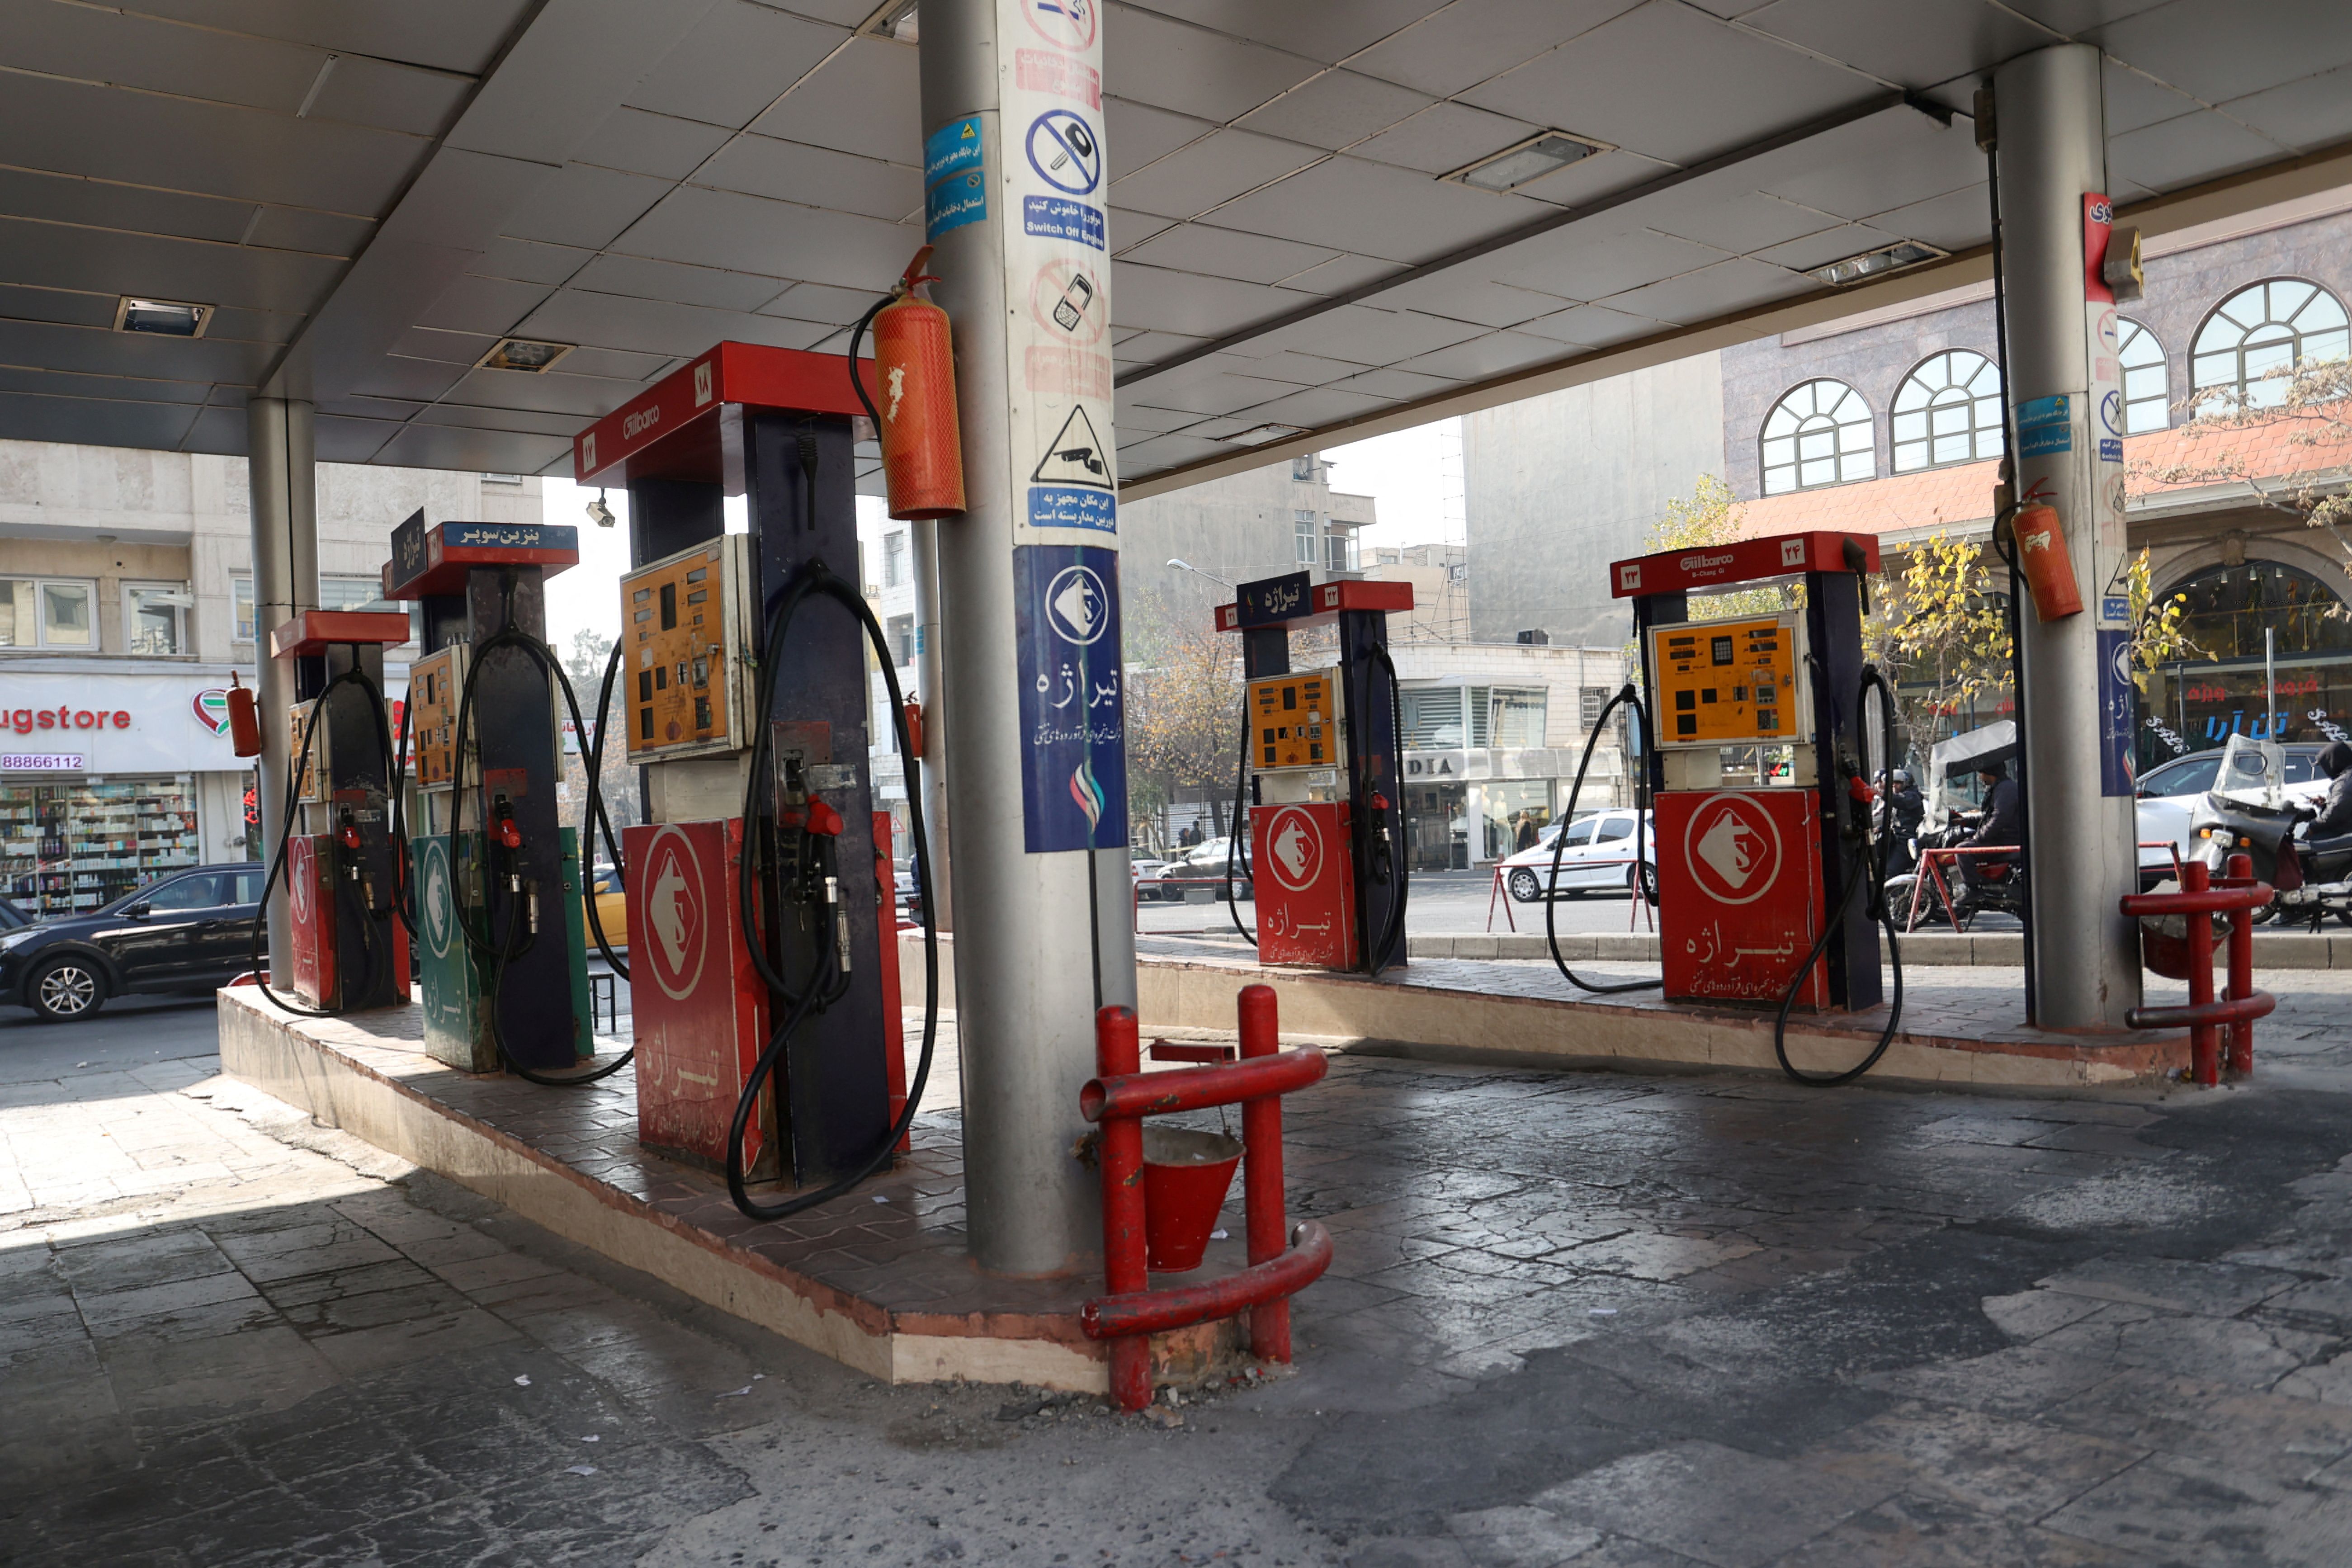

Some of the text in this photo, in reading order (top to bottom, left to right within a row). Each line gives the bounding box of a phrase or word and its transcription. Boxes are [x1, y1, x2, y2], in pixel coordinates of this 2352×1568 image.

[961, 195, 984, 213] استعمال
[1028, 200, 1048, 213] کنید
[1050, 202, 1079, 217] خاموش
[1026, 221, 1104, 246] Switch Off Engine
[699, 371, 709, 396] ۱۸
[623, 405, 660, 440] Gilbarco
[585, 441, 593, 463] ۱۷
[1044, 493, 1109, 510] این مکان مجهز به
[1034, 508, 1056, 520] است
[1095, 515, 1114, 529] دوربین
[460, 528, 540, 546] بنزین سوپر
[403, 524, 420, 570] تیراژه
[1785, 546, 1802, 561] ۲۴
[1680, 554, 1734, 571] Gilbarco
[1625, 570, 1638, 585] ۲۳
[1265, 582, 1300, 614] تیراژه
[1327, 590, 1337, 602] ۲۲
[1036, 659, 1118, 709] تیراژه
[3, 756, 82, 768] 88866112
[1268, 901, 1332, 939] تیراژه
[1686, 918, 1795, 968] تیراژه
[645, 1020, 721, 1099] تیراژه
